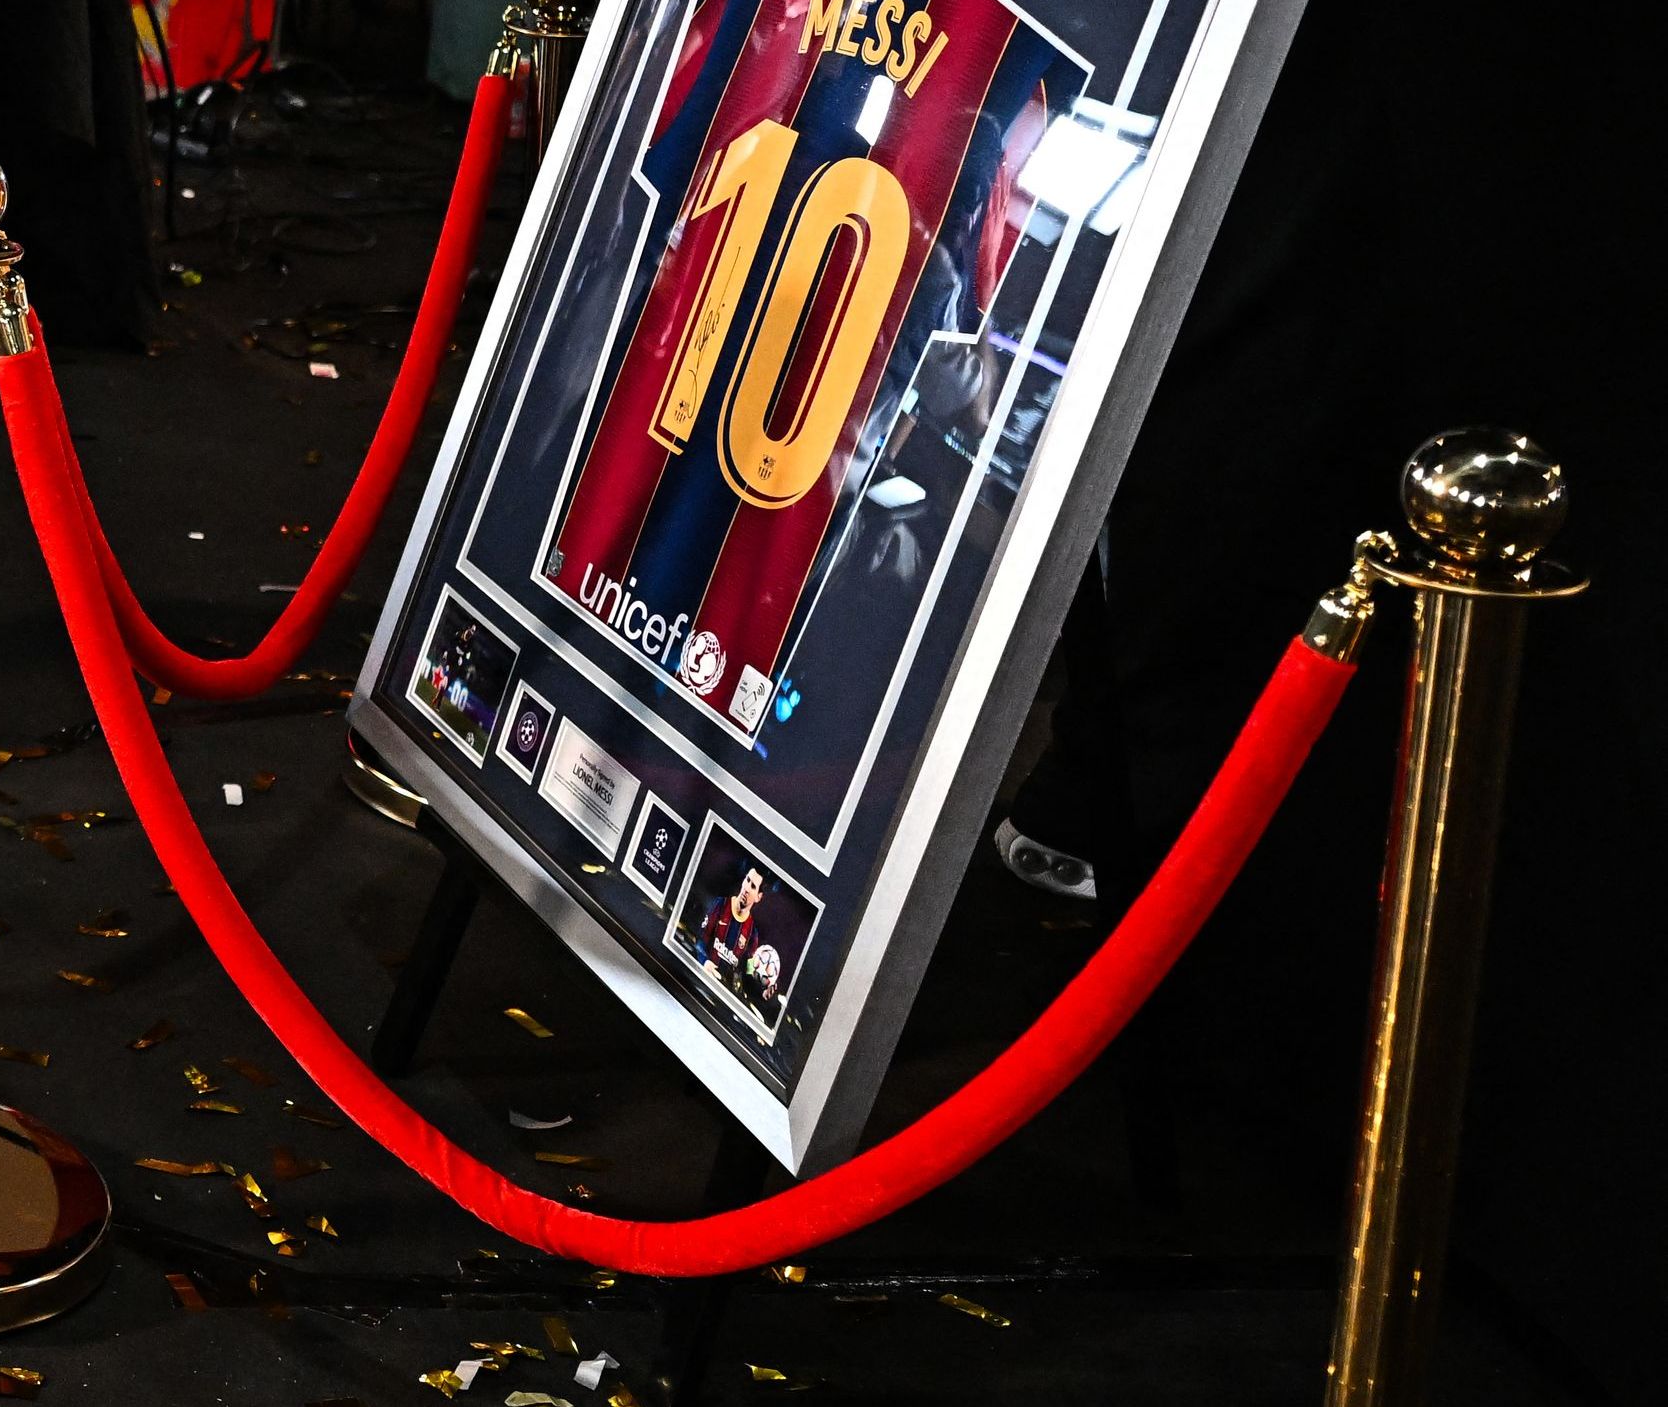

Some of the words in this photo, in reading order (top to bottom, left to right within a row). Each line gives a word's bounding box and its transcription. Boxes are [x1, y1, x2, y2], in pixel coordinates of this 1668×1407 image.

[648, 118, 911, 510] 10
[579, 562, 689, 665] unicef
[571, 762, 595, 790] LIONEL
[592, 780, 614, 807] MESSI
